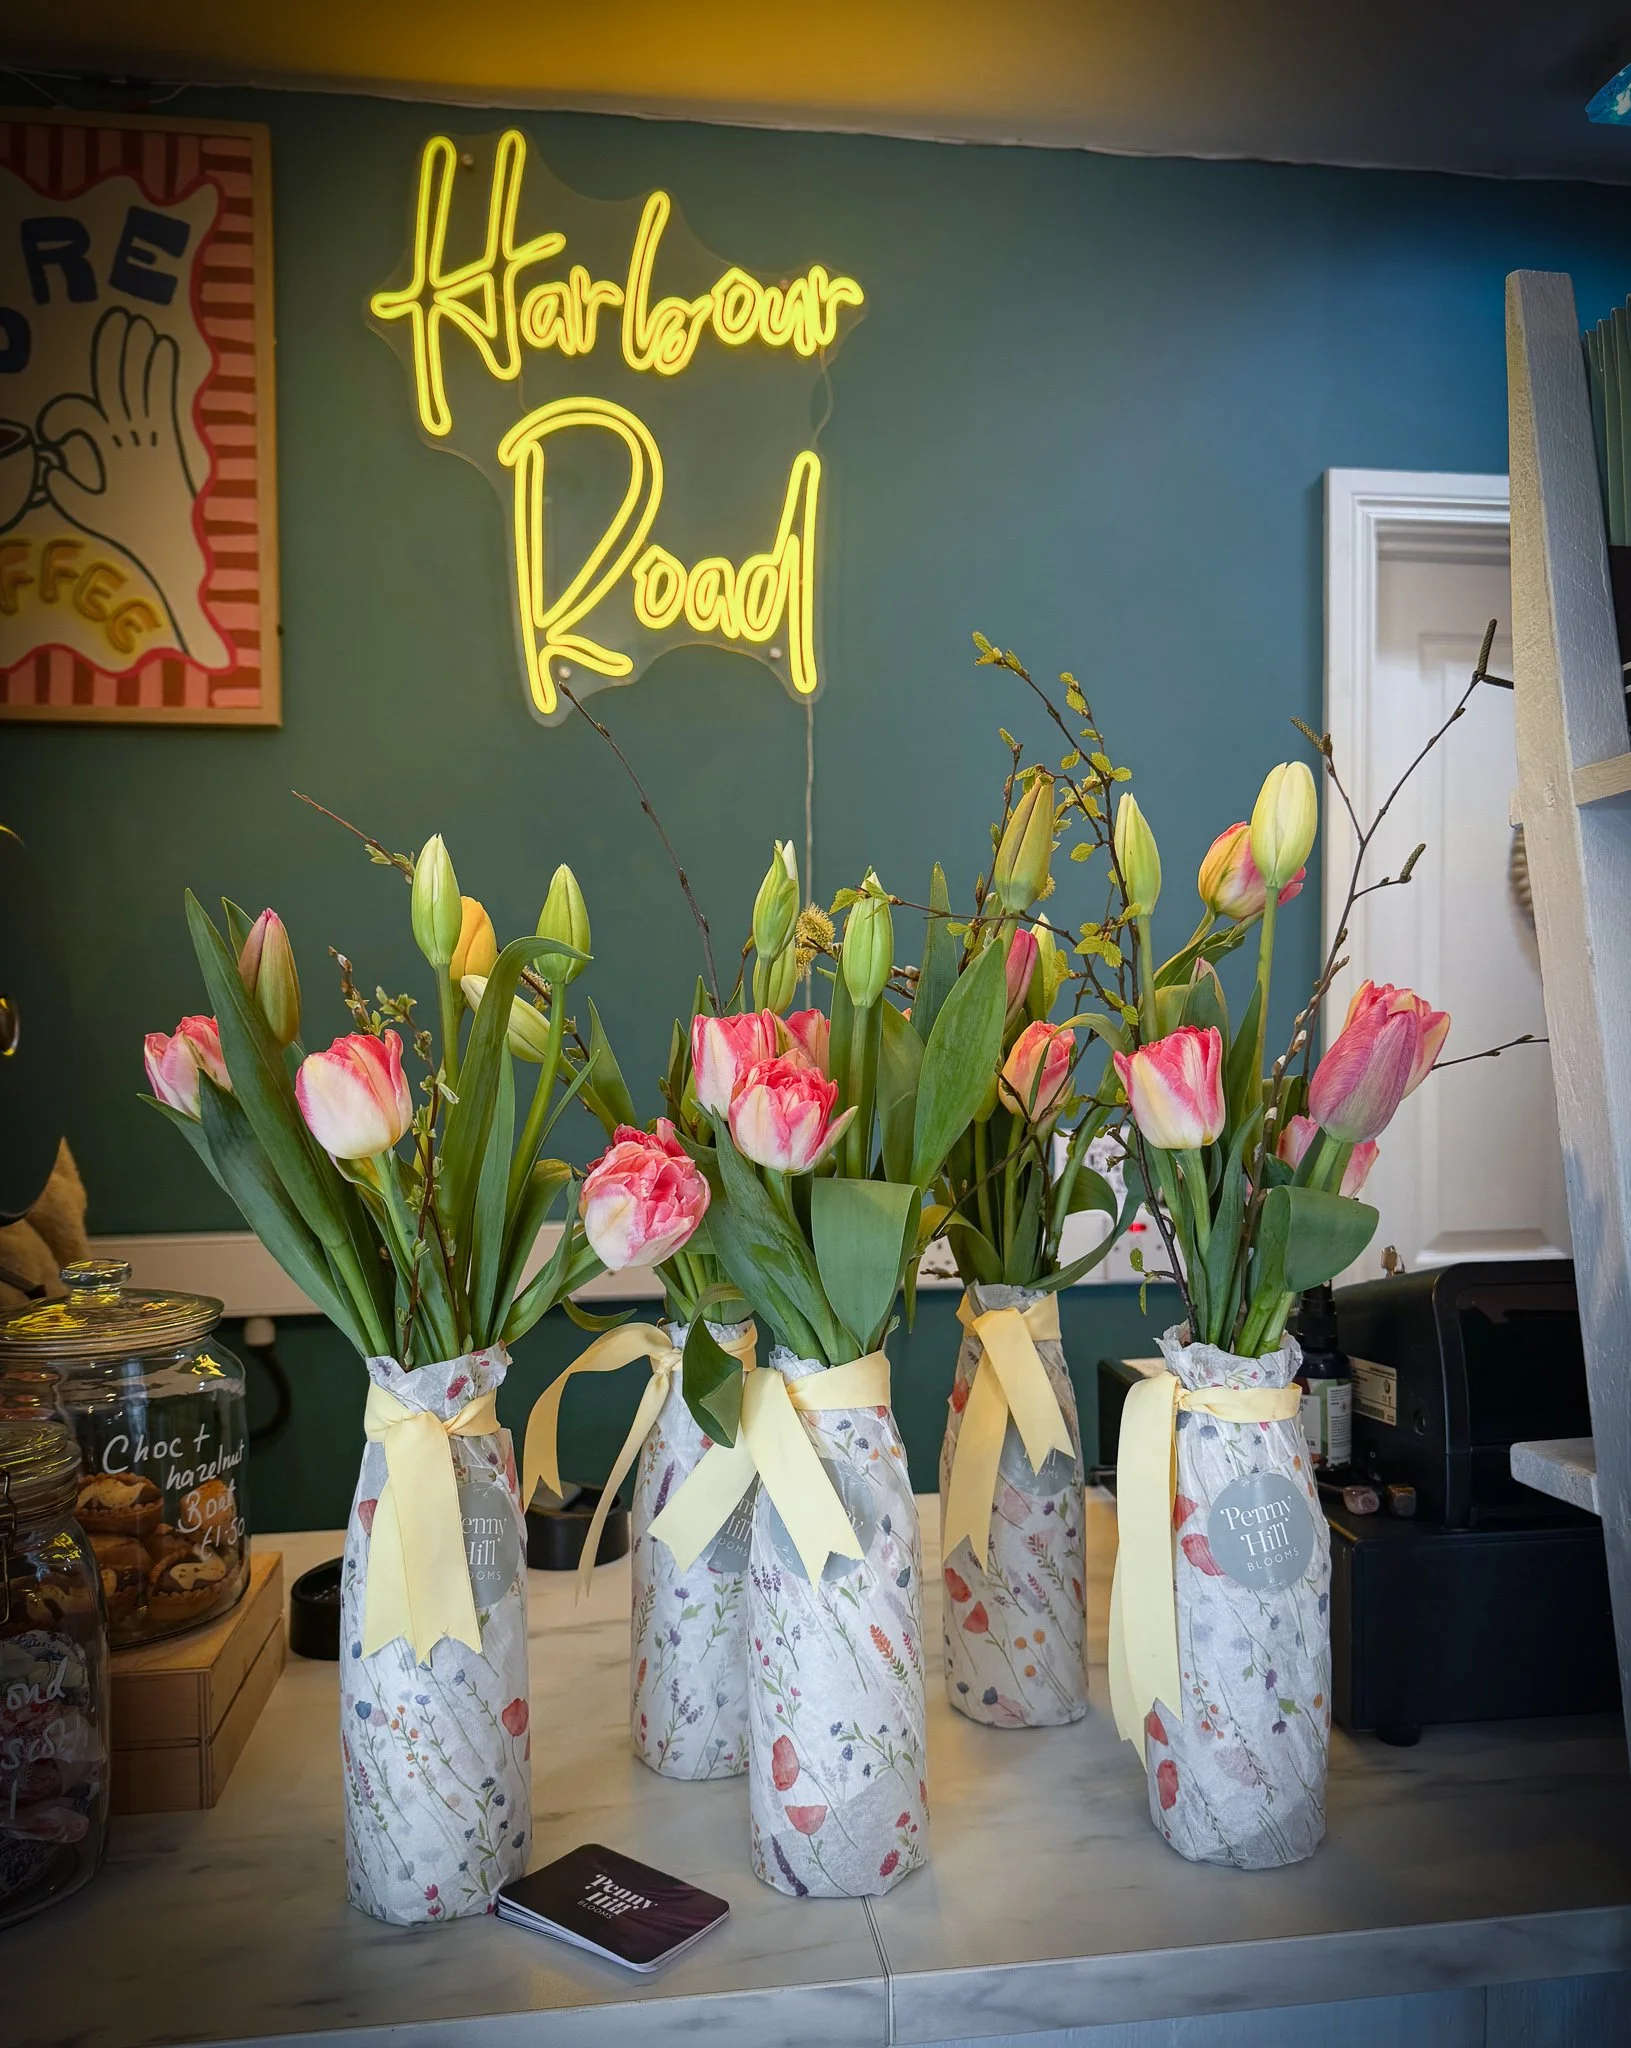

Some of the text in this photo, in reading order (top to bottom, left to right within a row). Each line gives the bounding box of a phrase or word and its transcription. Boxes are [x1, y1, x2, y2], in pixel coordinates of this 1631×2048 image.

[370, 128, 865, 437] Harbour
[498, 396, 821, 714] Road
[102, 1433, 184, 1475] Choc
[165, 1438, 245, 1490] hazelnut
[462, 1517, 507, 1543] enny
[1220, 1495, 1292, 1531] Penny
[1240, 1522, 1290, 1557] Hill
[1247, 1547, 1300, 1572] BLOOMS
[578, 1900, 613, 1920] BLOOMS
[585, 1885, 632, 1915] Hill
[590, 1874, 658, 1911] Penny
